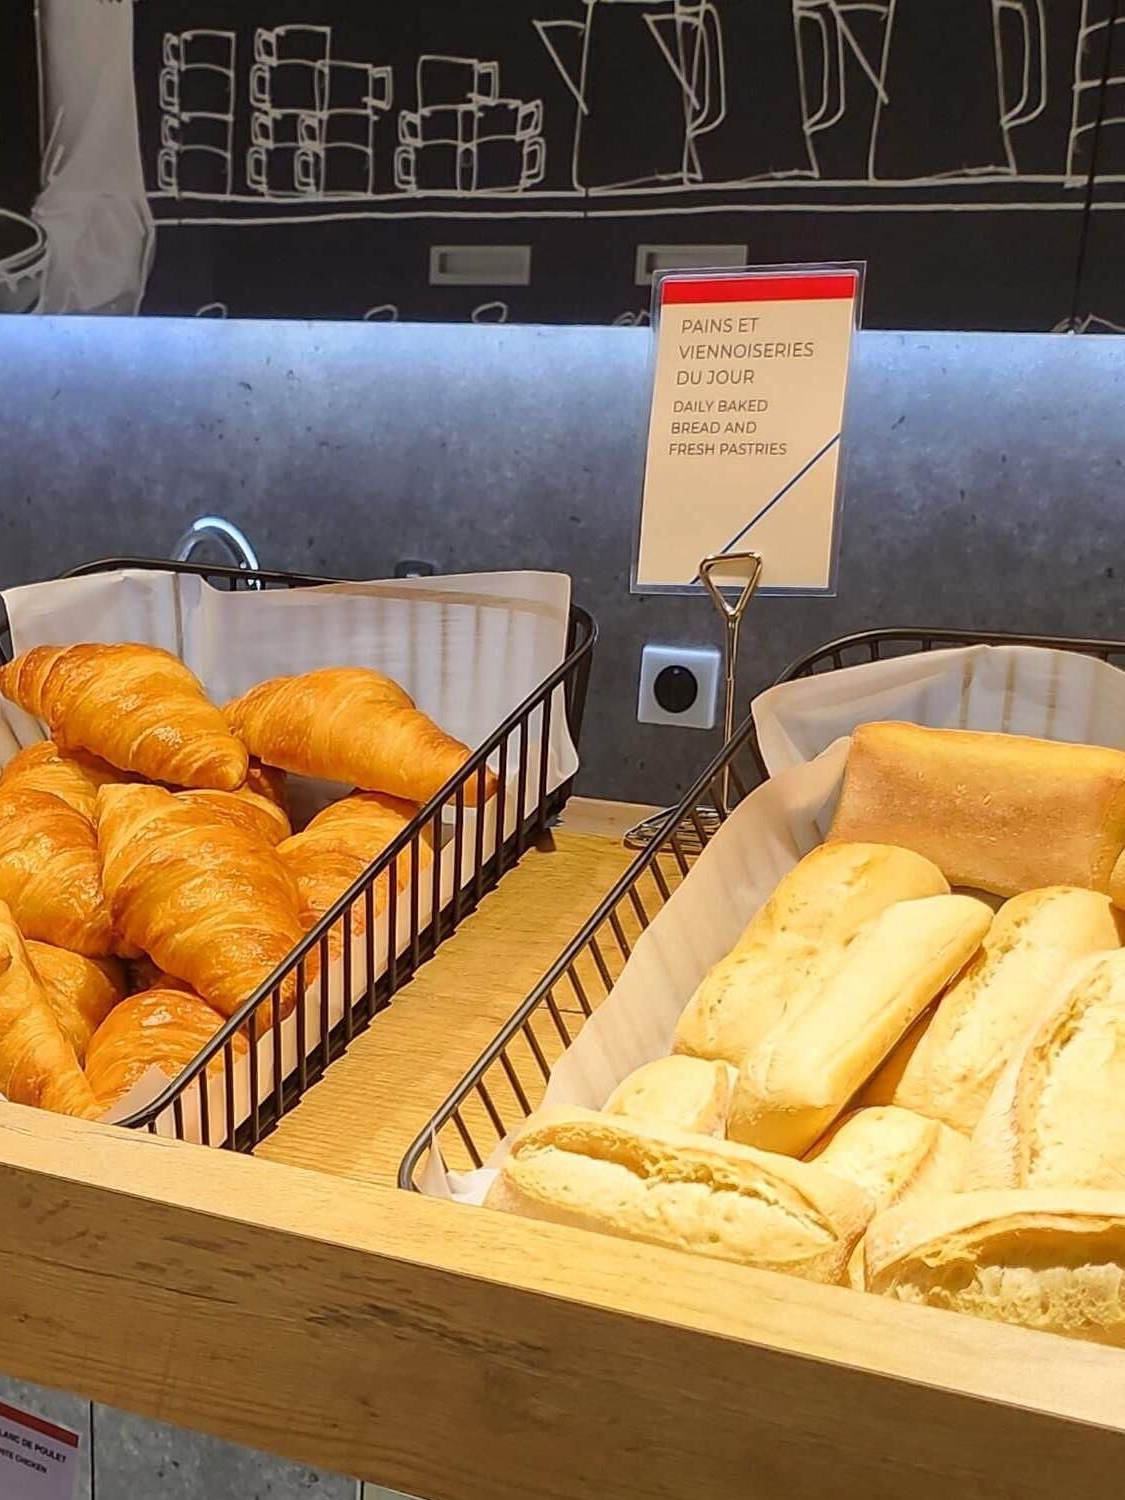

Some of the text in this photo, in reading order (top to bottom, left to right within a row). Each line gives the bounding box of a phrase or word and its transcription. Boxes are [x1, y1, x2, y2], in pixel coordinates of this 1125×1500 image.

[681, 317, 760, 333] PAINS ET
[678, 342, 814, 360] VIENNOISERIES
[676, 369, 755, 385] DU JOUR
[673, 399, 768, 413] DAILY BAKED
[671, 421, 757, 435] BREAD AND
[668, 443, 787, 456] FRESH PASTRIES
[22, 1438, 33, 1450] DE
[35, 1444, 66, 1463] POULET
